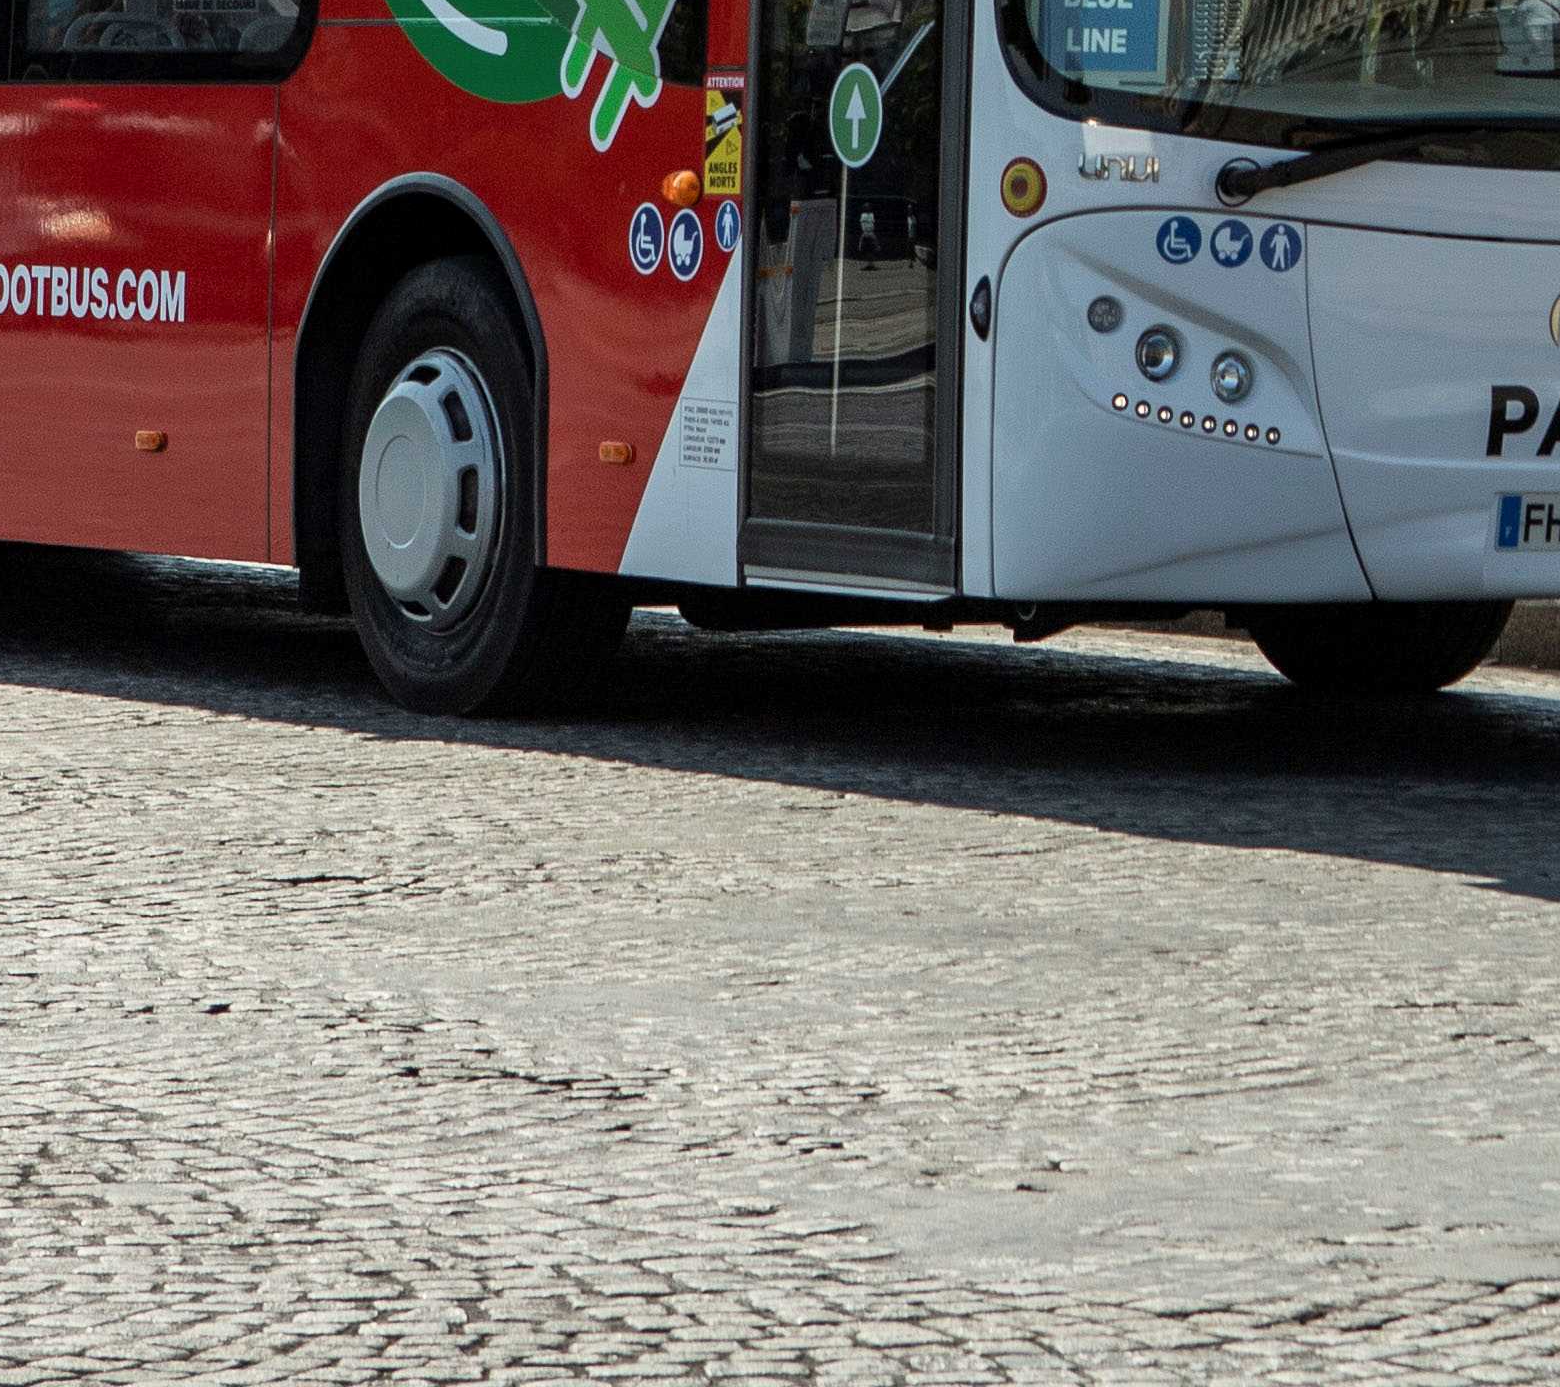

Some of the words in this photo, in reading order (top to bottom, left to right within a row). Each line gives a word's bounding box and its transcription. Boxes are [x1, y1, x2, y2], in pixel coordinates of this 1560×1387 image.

[1066, 27, 1128, 54] LINE
[706, 76, 745, 88] ATTENTION
[708, 162, 738, 174] ANGLES
[708, 175, 736, 188] MORTS
